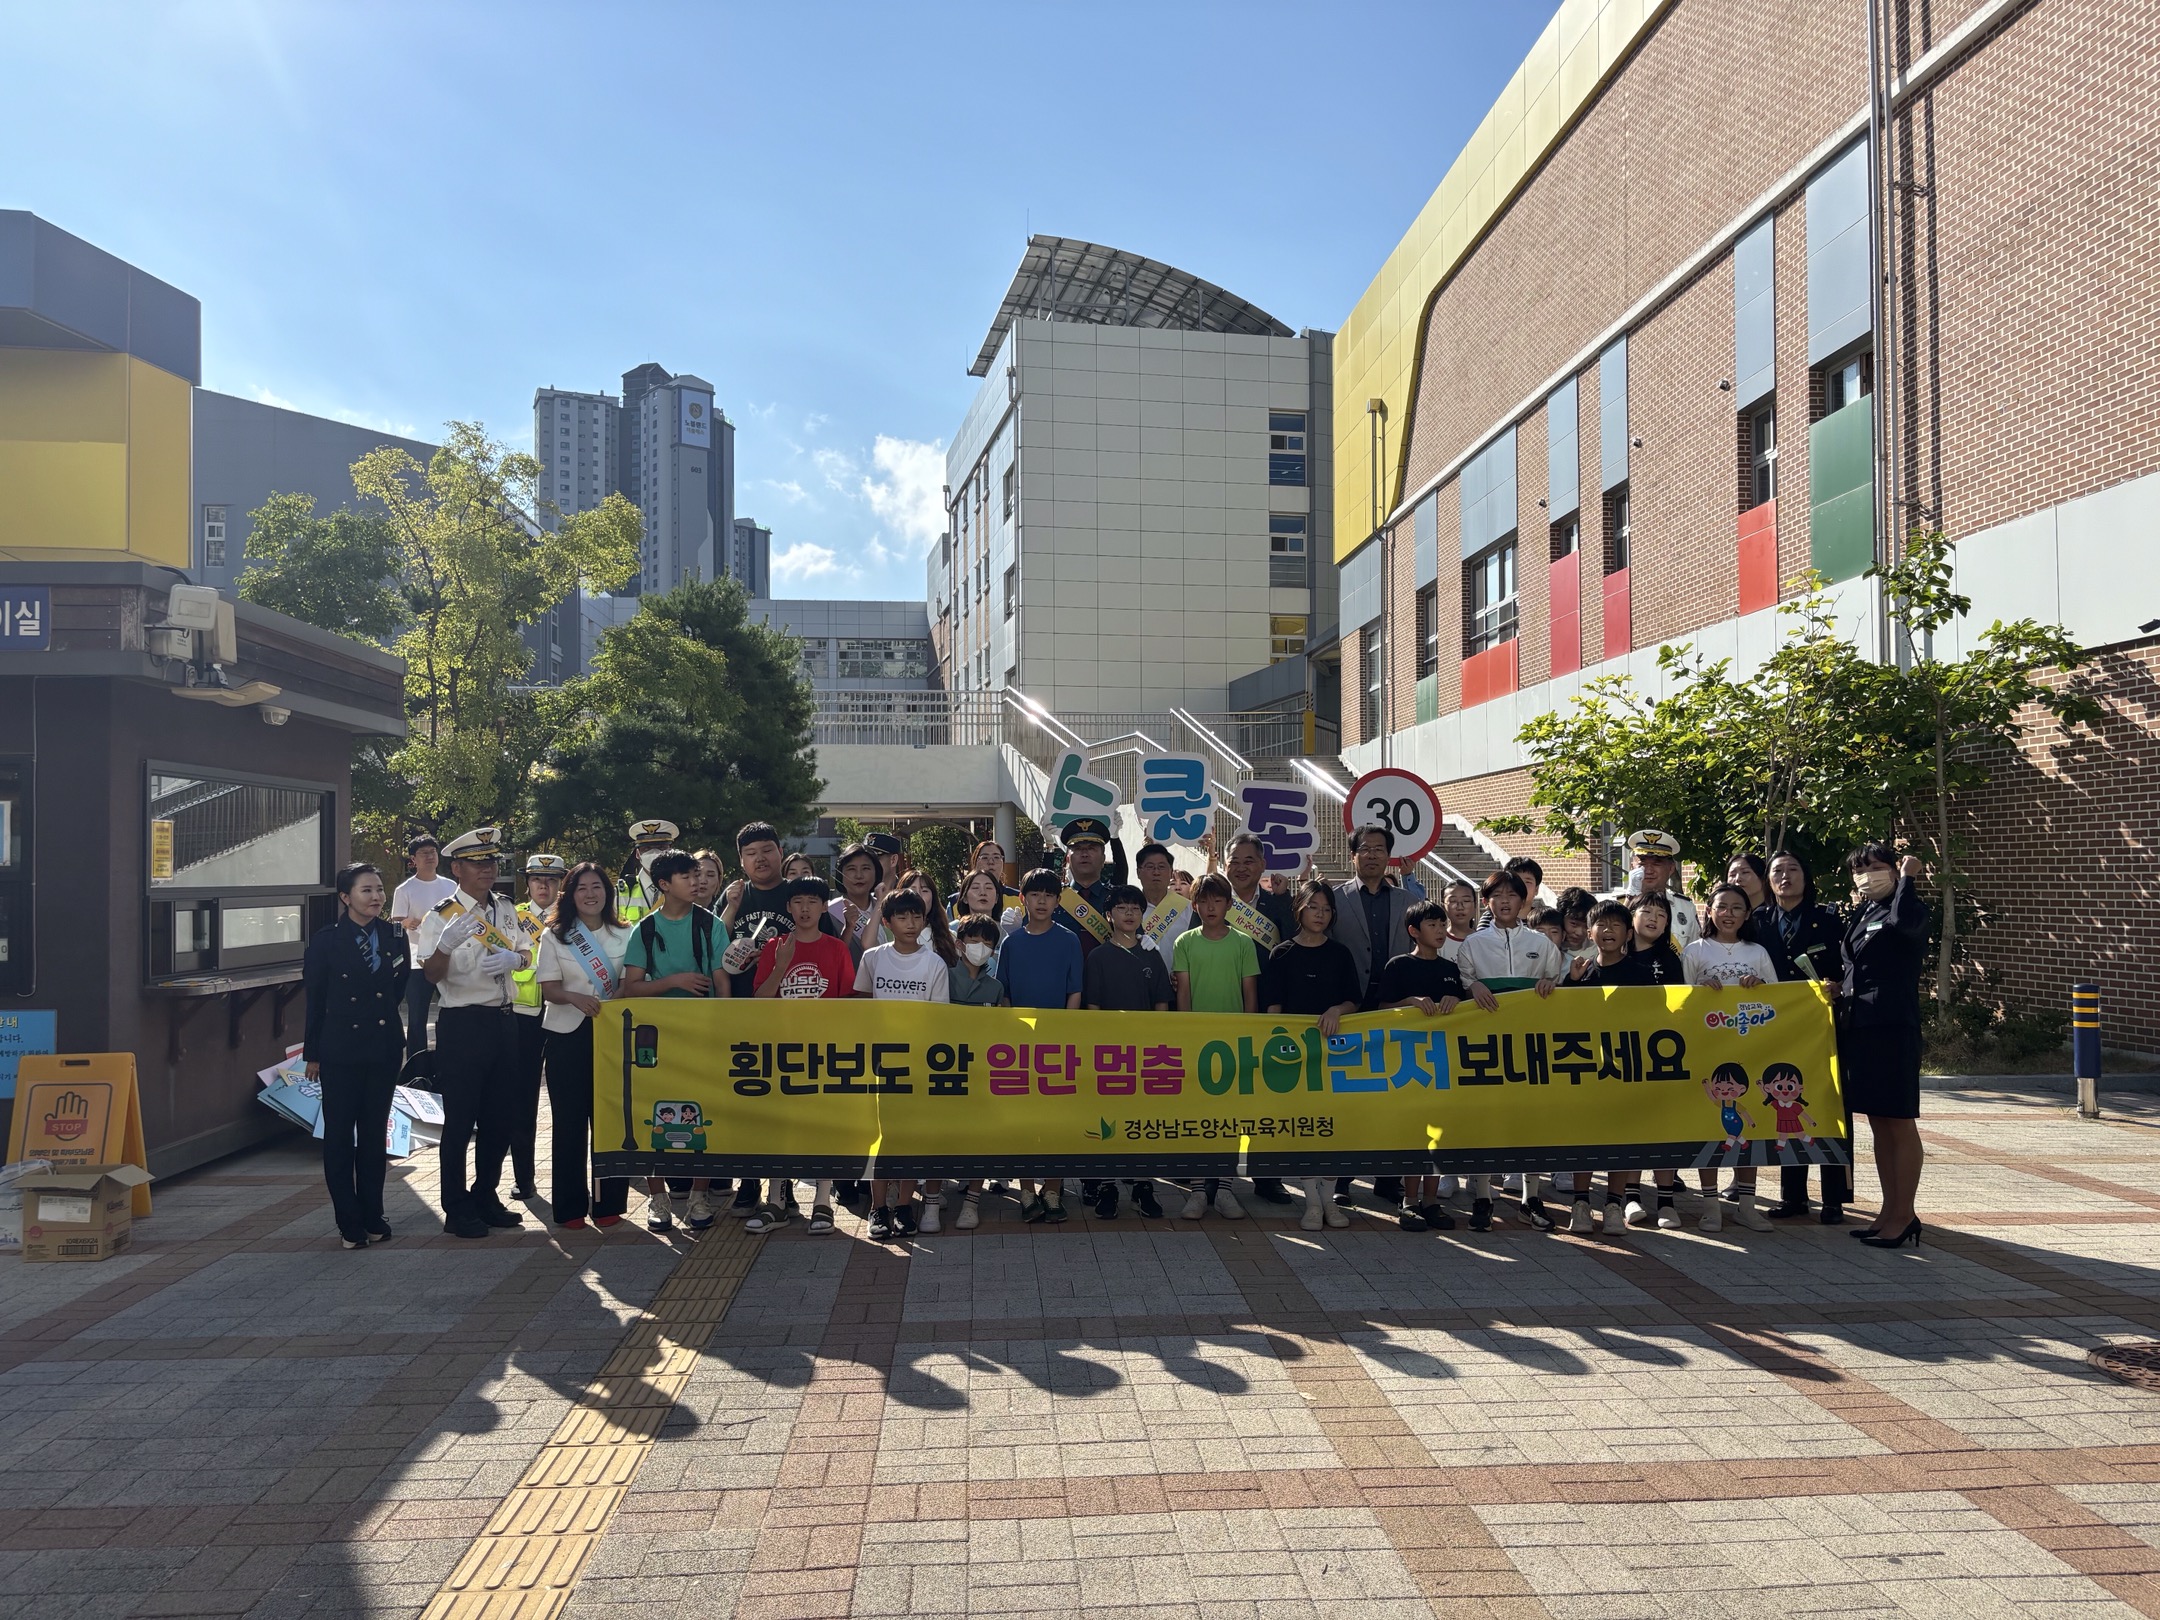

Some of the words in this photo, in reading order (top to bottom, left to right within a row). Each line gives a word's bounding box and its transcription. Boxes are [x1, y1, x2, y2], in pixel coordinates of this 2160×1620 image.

[691, 466, 702, 474] 603
[1366, 797, 1421, 836] 30
[1076, 905, 1088, 917] 30
[733, 918, 745, 930] LIVE
[745, 911, 761, 922] FAST
[761, 910, 775, 921] RIDE
[775, 913, 797, 932] FASTER
[1235, 915, 1273, 945] 주정차를
[1254, 915, 1275, 933] 주변
[780, 975, 830, 988] MUSCLE
[876, 977, 927, 991] Dcovers
[1738, 1003, 1763, 1011] 경남교육
[1705, 1008, 1776, 1035] 아이좋아
[728, 1041, 914, 1096] 횡단보도
[926, 1042, 975, 1096] 앞
[986, 1042, 1081, 1096] 일단
[1093, 1042, 1186, 1096] 멈춤
[1458, 1029, 1691, 1087] 보내주세요
[52, 1123, 82, 1132] STOP
[1124, 1116, 1335, 1140] 경상남도양산교육지원청
